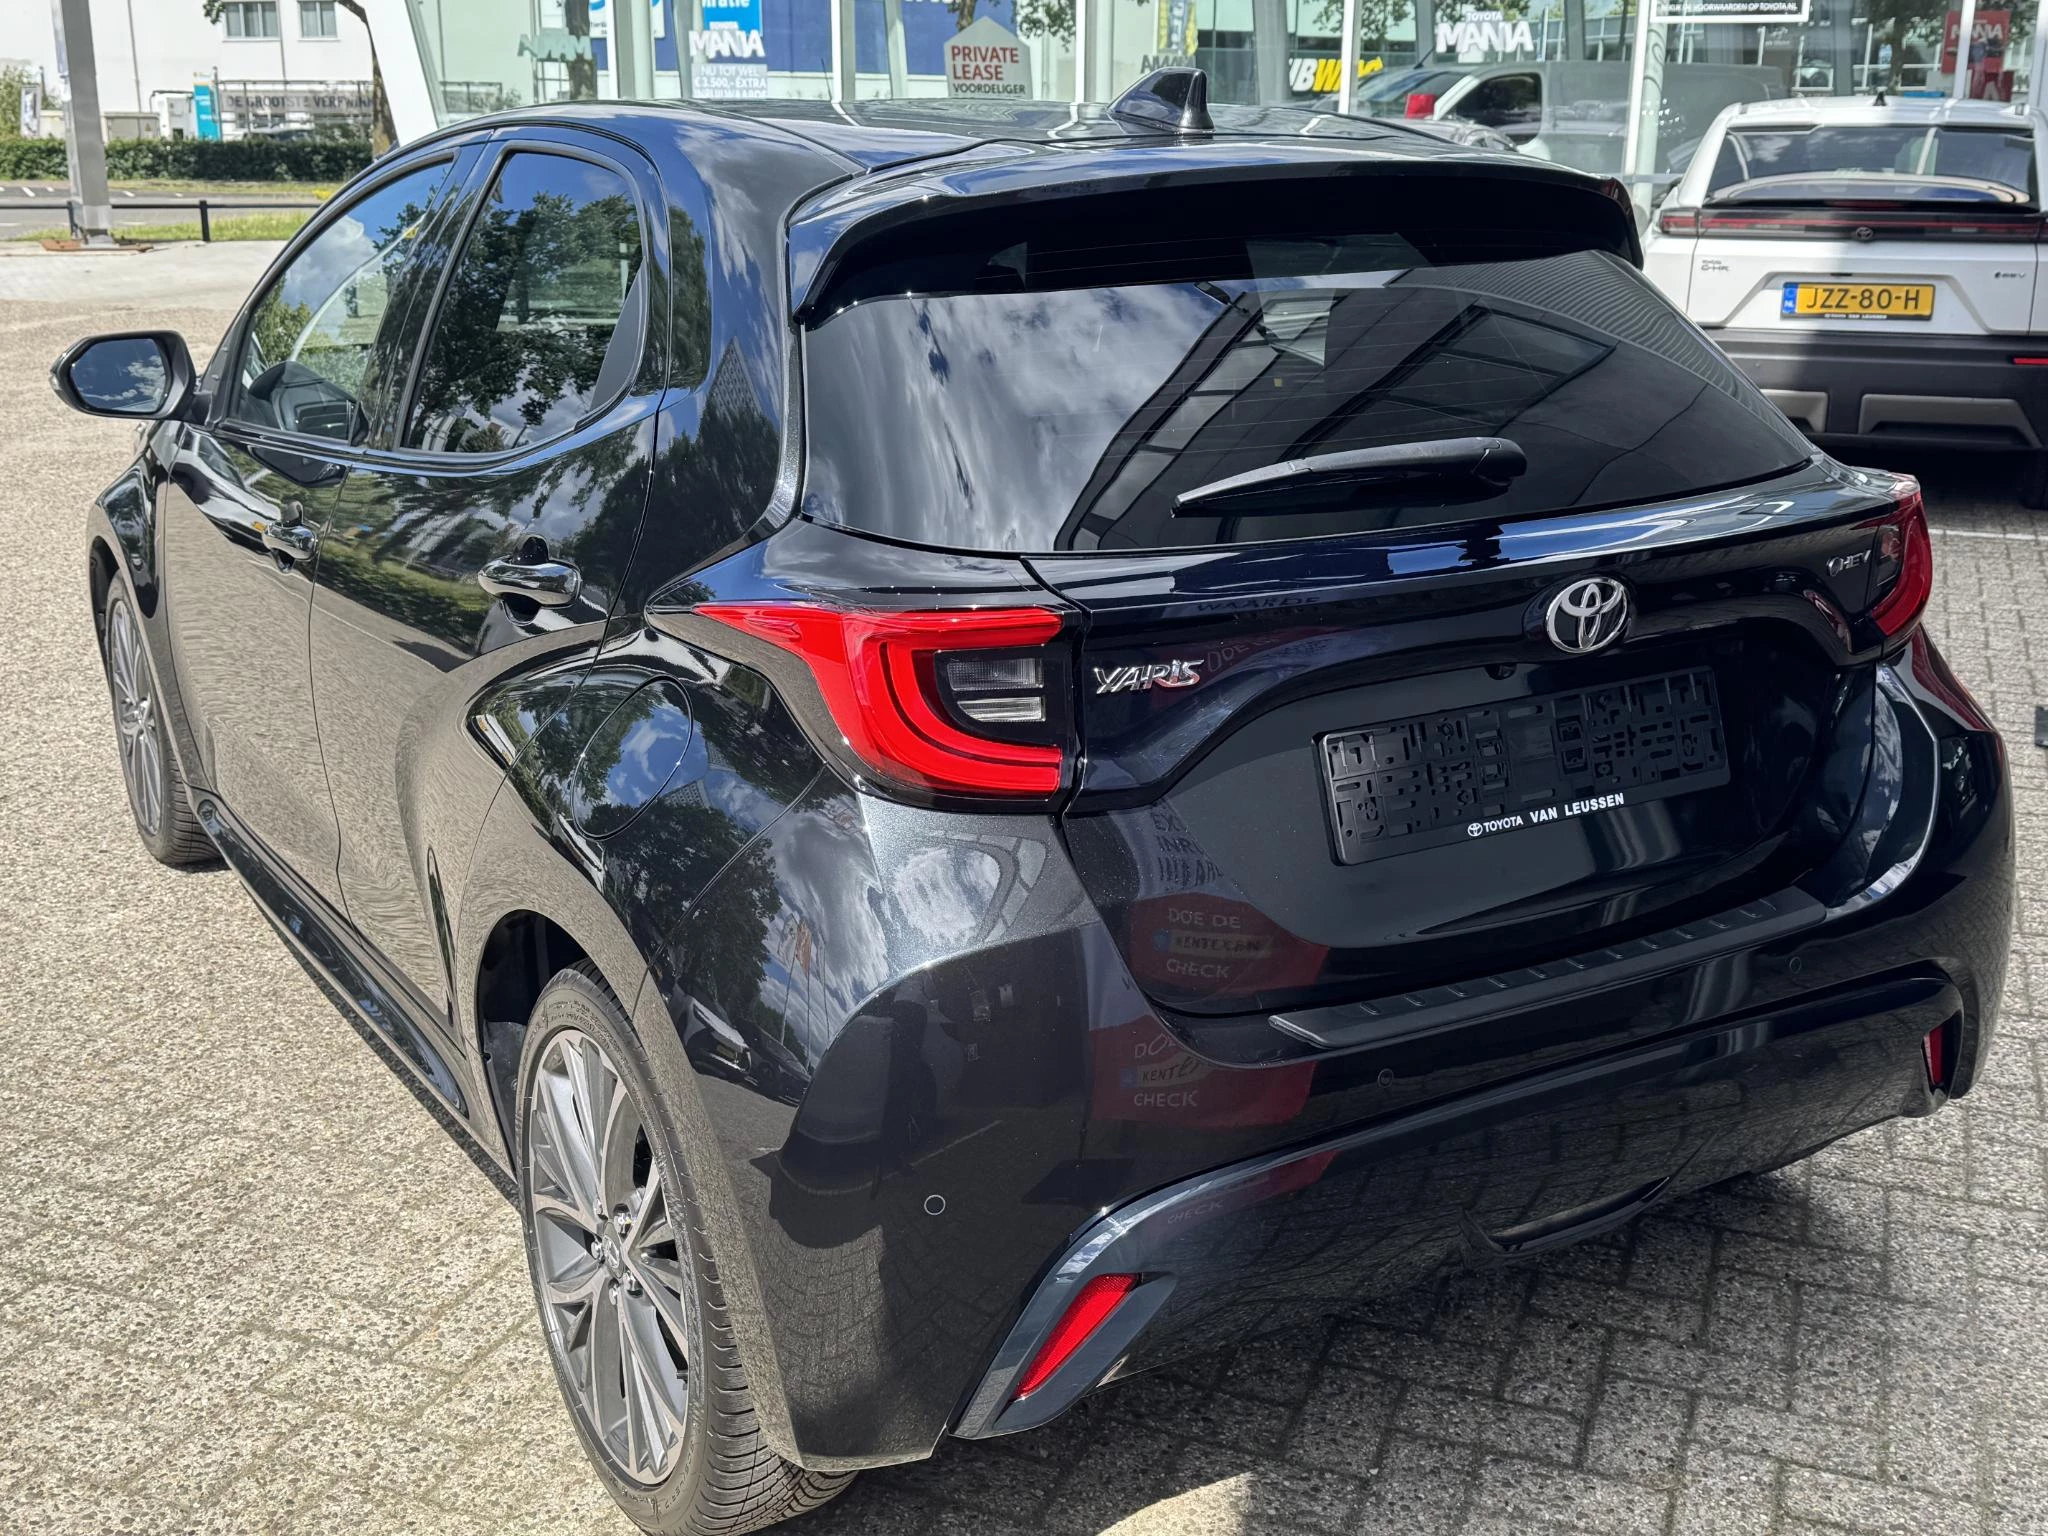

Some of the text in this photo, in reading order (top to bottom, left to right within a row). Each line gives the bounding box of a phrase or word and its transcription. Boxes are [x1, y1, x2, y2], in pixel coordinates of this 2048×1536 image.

[1466, 11, 1503, 21] TOYOTA
[688, 29, 766, 59] MANIA
[1435, 20, 1534, 53] MANIA
[951, 45, 1019, 64] PRIVATE
[952, 63, 1003, 81] LEASE
[953, 82, 1026, 95] VOORDELIGER
[1806, 287, 1920, 311] JZZ-80-H
[1094, 659, 1205, 694] YARIS
[1484, 792, 1625, 832] TOYOTA VAN LEUSSEN
[1168, 907, 1205, 926] DOE
[1166, 958, 1231, 978] CHECK
[1134, 1089, 1198, 1107] CHECK
